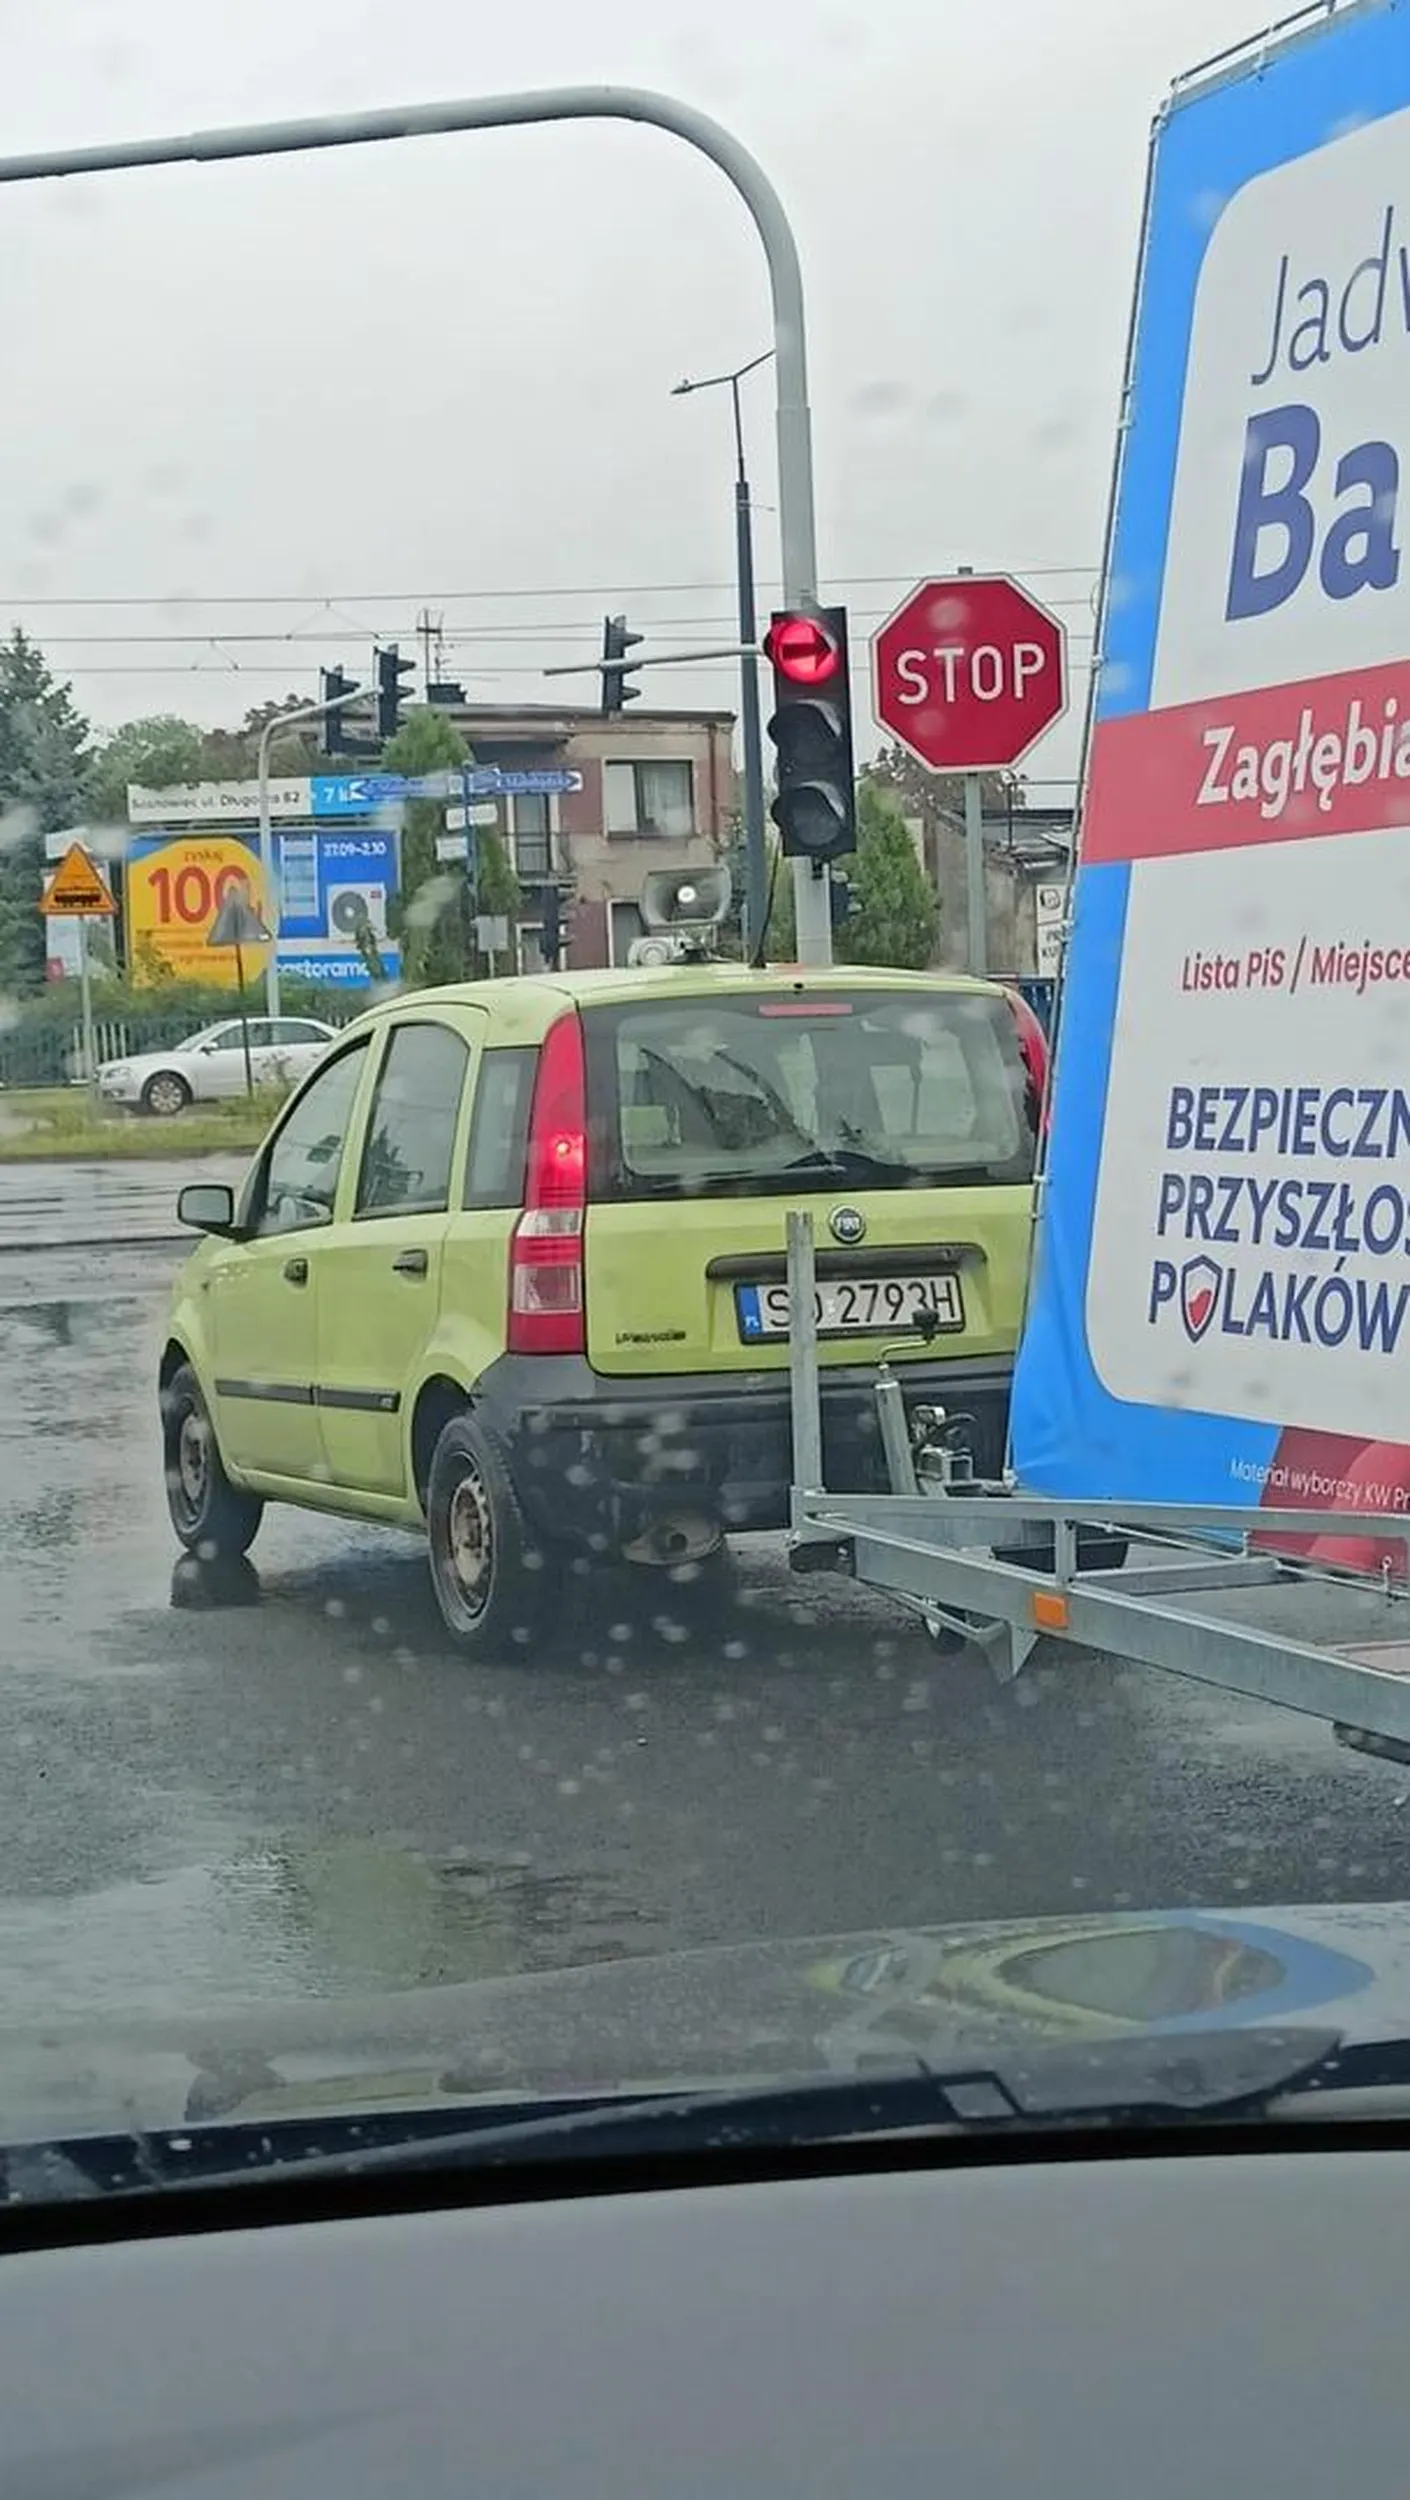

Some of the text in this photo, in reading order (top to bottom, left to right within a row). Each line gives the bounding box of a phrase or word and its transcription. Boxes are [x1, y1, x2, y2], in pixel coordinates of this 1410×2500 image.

[1225, 404, 1400, 621] Ba
[896, 642, 1046, 705] STOP
[1182, 936, 1410, 996] Lista PiS / Miejsce
[1157, 1173, 1410, 1256] PRZYSZŁO
[837, 1280, 957, 1325] 2793H
[1291, 1469, 1362, 1507] wyborczy
[1365, 1481, 1392, 1507] KW
